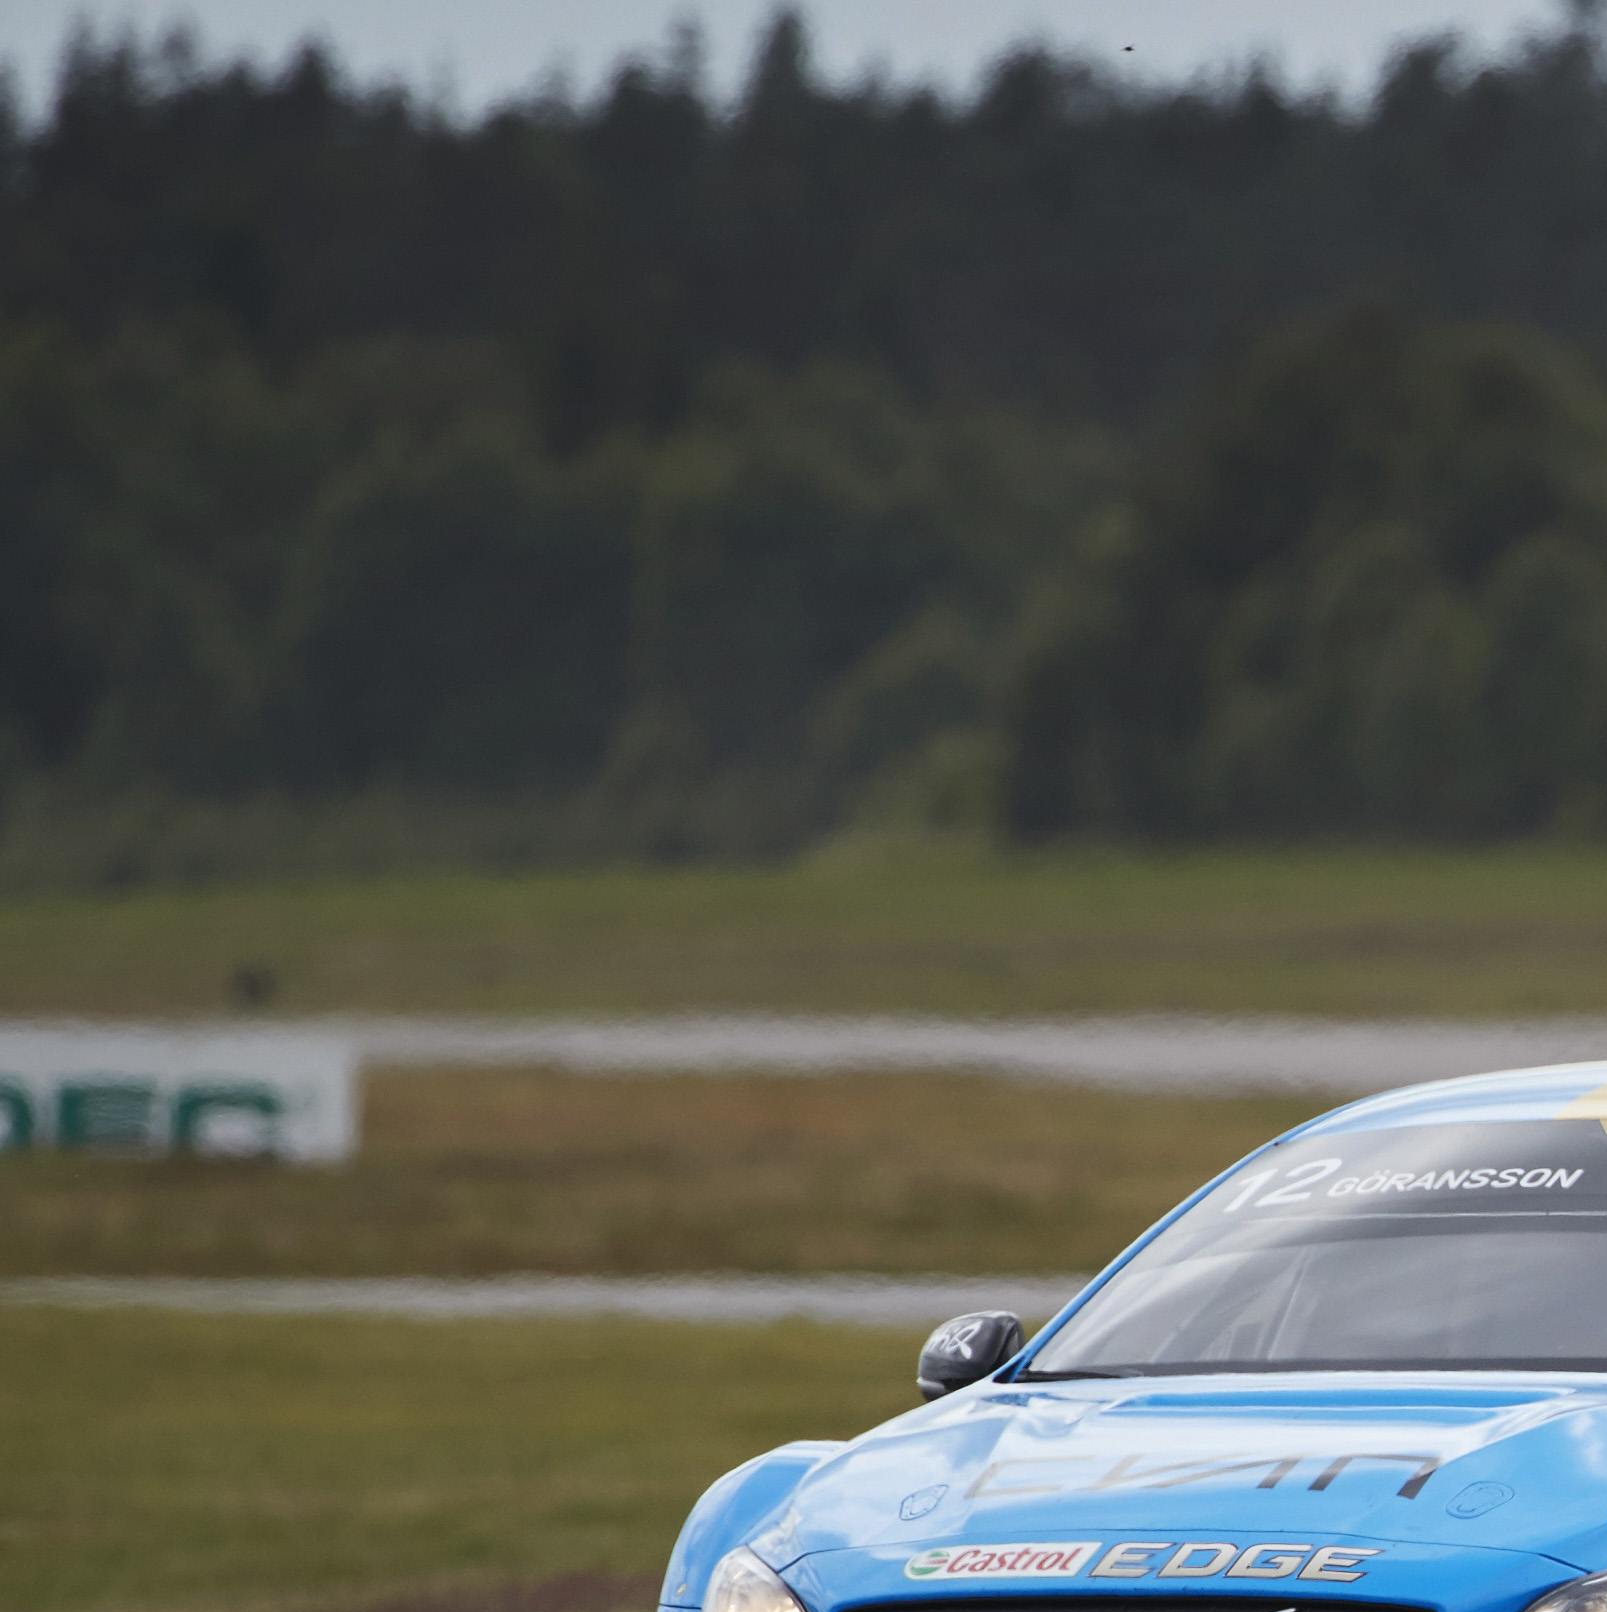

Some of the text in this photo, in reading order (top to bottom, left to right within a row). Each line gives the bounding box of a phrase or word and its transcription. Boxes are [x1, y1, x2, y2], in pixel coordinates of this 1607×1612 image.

[1223, 1158, 1584, 1214] 12 GÖRANSSON
[948, 1542, 1385, 1582] Castrol EDGE
